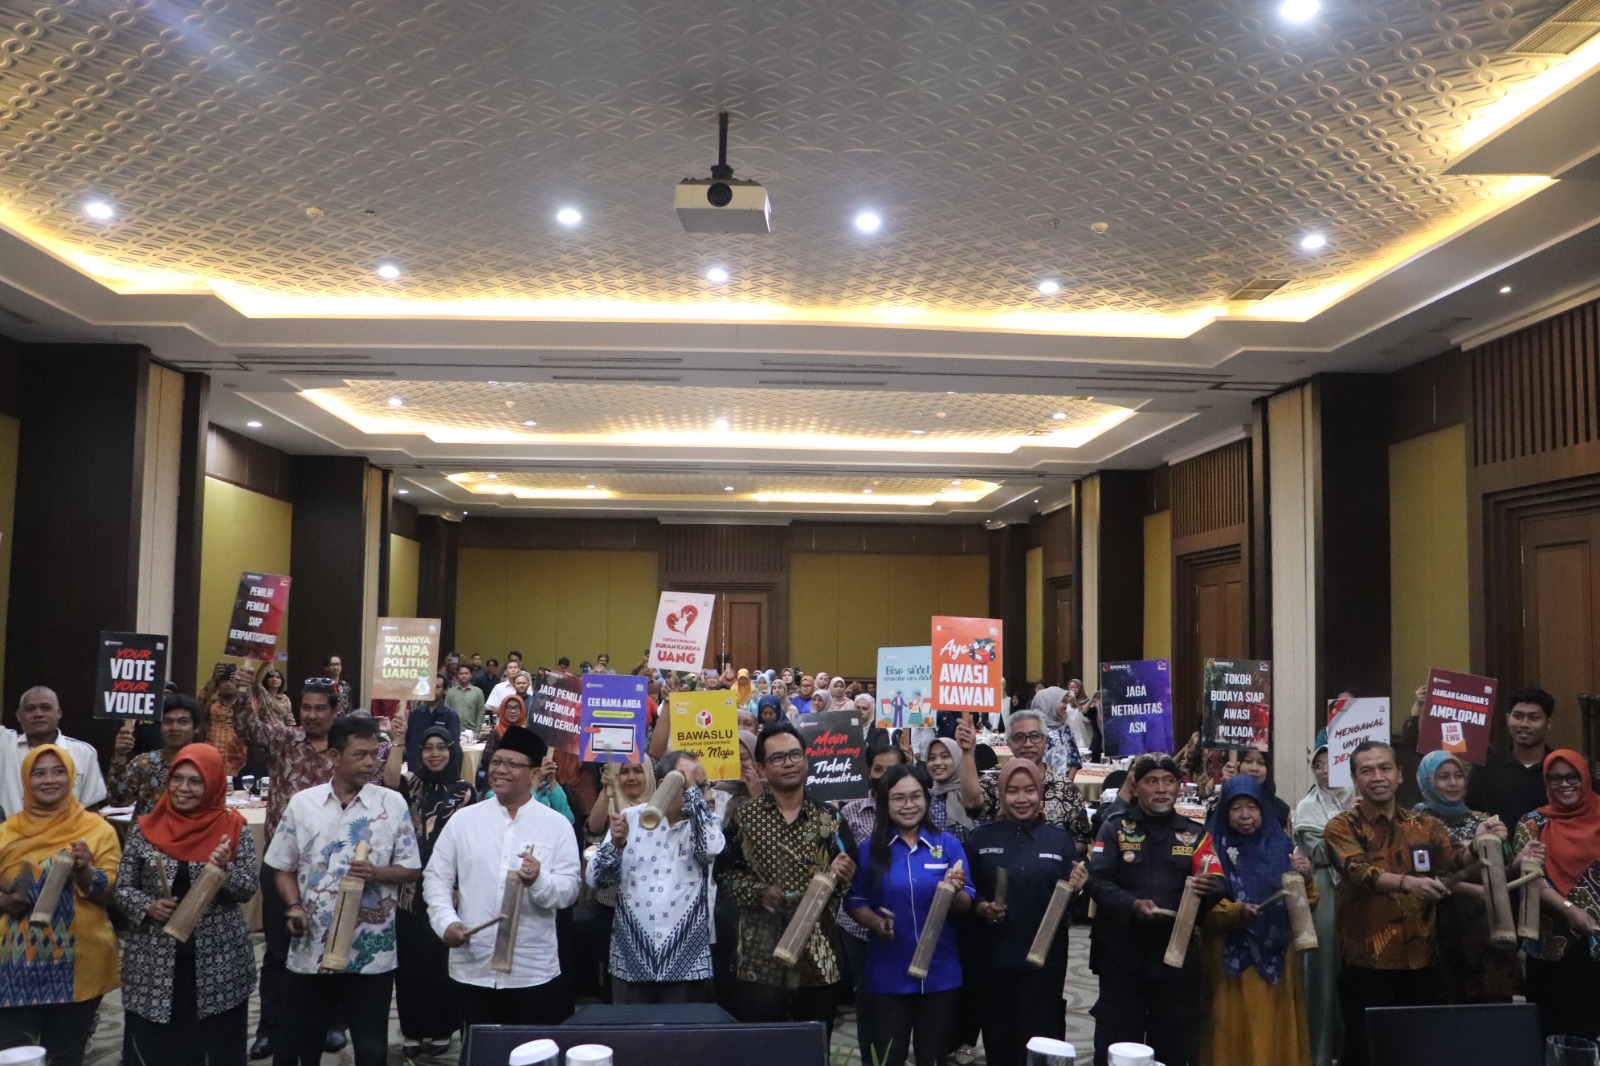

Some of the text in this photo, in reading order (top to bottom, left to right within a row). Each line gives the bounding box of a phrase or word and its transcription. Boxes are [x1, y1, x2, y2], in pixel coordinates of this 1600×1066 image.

[245, 601, 270, 613] PEMULA
[385, 635, 431, 644] INDAHNYA
[115, 648, 153, 659] YOUR
[384, 644, 430, 656] TANPA
[939, 638, 970, 660] Ayo
[382, 656, 429, 668] POLITIK
[657, 650, 696, 665] UANG
[110, 657, 156, 681] VOTE
[382, 668, 418, 679] UANG
[939, 663, 989, 684] AWASI
[1224, 673, 1252, 685] TOKOH
[113, 680, 150, 692] YOUR
[539, 684, 557, 697] JADI
[1125, 685, 1147, 698] JAGA
[939, 685, 995, 707] KAWAN
[1210, 690, 1265, 703] BUDAYA SIAP
[1432, 688, 1455, 700] JANGAN
[104, 691, 156, 714] VOICE
[587, 697, 642, 709] CEK NAMA ANDA
[1111, 702, 1163, 716] NETRALITAS
[544, 701, 575, 718] PEMULA
[1223, 708, 1250, 720] AWASI
[1429, 704, 1487, 726] AMPLOPAN
[533, 712, 553, 727] YANG
[1129, 721, 1147, 734] ASN
[1219, 725, 1254, 738] PILKADA
[1334, 717, 1385, 739] MENGAWAL
[1445, 725, 1458, 733] 100
[677, 729, 733, 741] BAWASLU
[813, 730, 848, 746] Main
[1445, 733, 1460, 742] EWU
[707, 746, 735, 760] Maju
[804, 745, 861, 758] Politik uang
[813, 757, 852, 774] Tidak
[805, 772, 863, 786] Berkualitas
